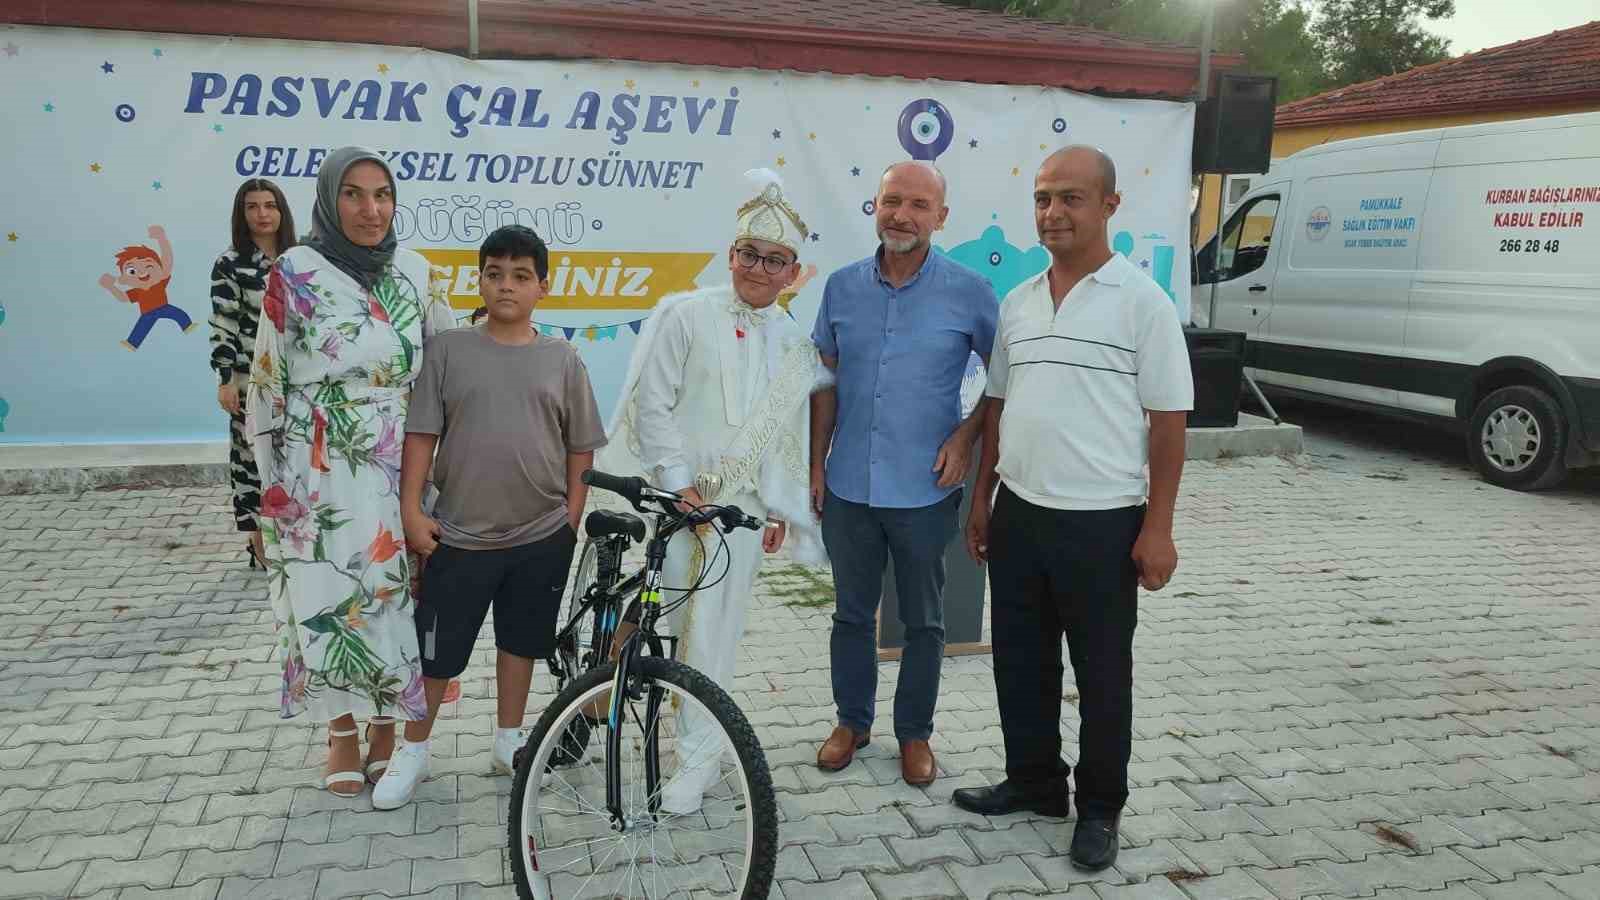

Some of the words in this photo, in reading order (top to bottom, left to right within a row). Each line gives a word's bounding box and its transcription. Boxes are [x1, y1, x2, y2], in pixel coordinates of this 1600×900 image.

[184, 72, 428, 122] PASVAK
[446, 83, 550, 138] ÇAL
[565, 86, 740, 145] AŞEVİ
[465, 153, 575, 185] TOPLU
[577, 150, 703, 189] SÜNNET
[1485, 189, 1527, 204] KURBAN
[1494, 212, 1535, 227] KABUL
[1539, 209, 1584, 227] EDİLİR
[1499, 239, 1521, 252] 266
[1524, 239, 1540, 252] 28
[1544, 239, 1560, 252] 48
